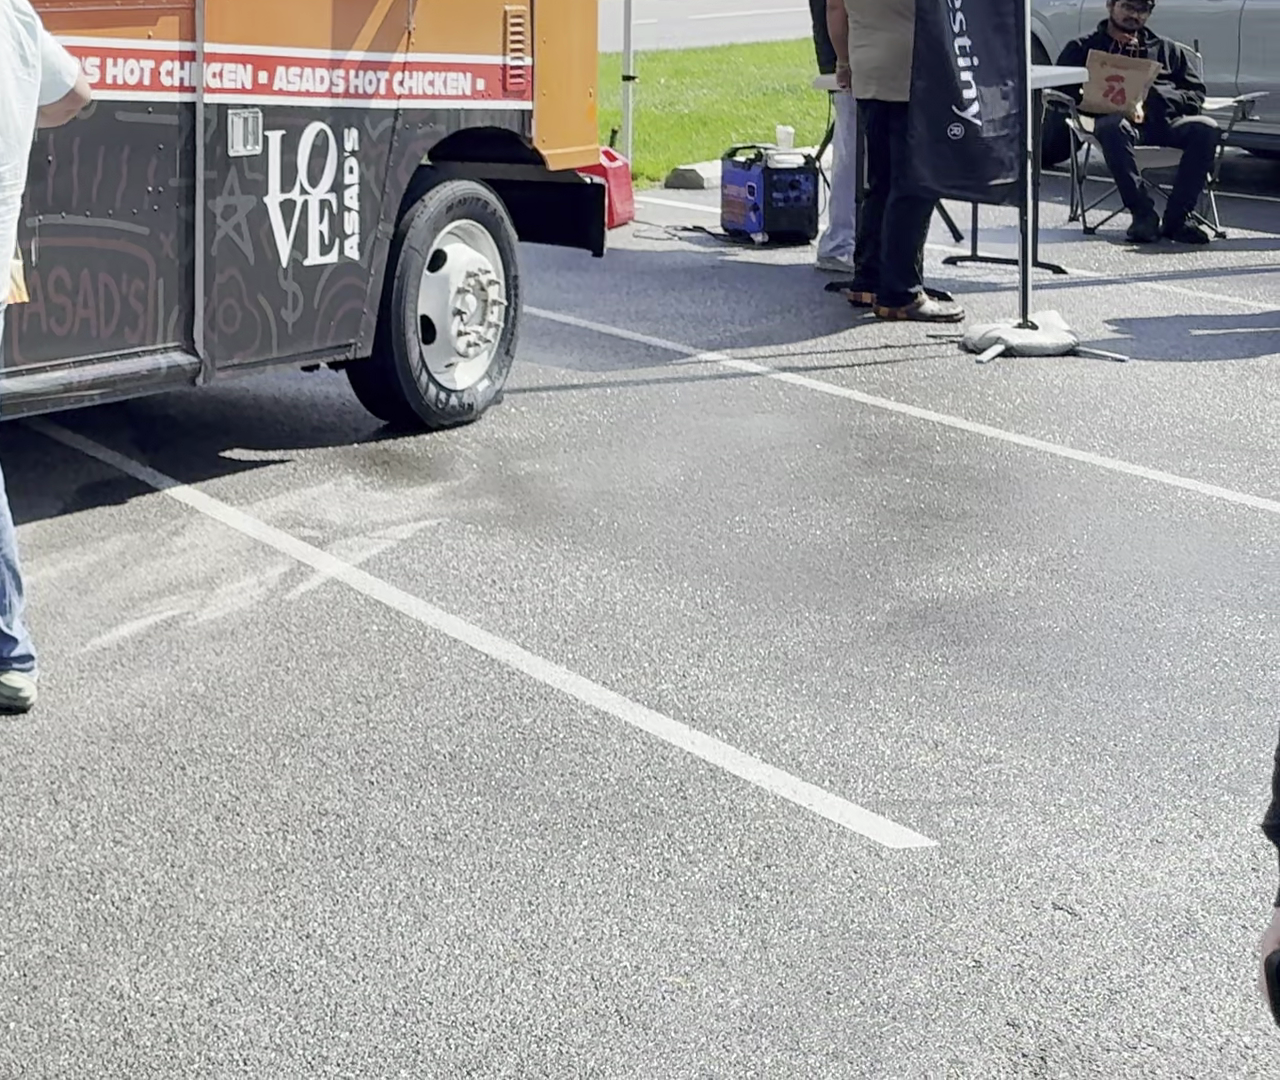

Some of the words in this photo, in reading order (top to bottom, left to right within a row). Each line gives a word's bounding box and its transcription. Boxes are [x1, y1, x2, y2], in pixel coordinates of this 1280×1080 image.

[106, 57, 155, 86] HOT
[273, 65, 345, 94] ASAD'S
[349, 69, 389, 96] HOT
[393, 71, 472, 97] CHICKEN
[343, 126, 360, 261] ASAD'S
